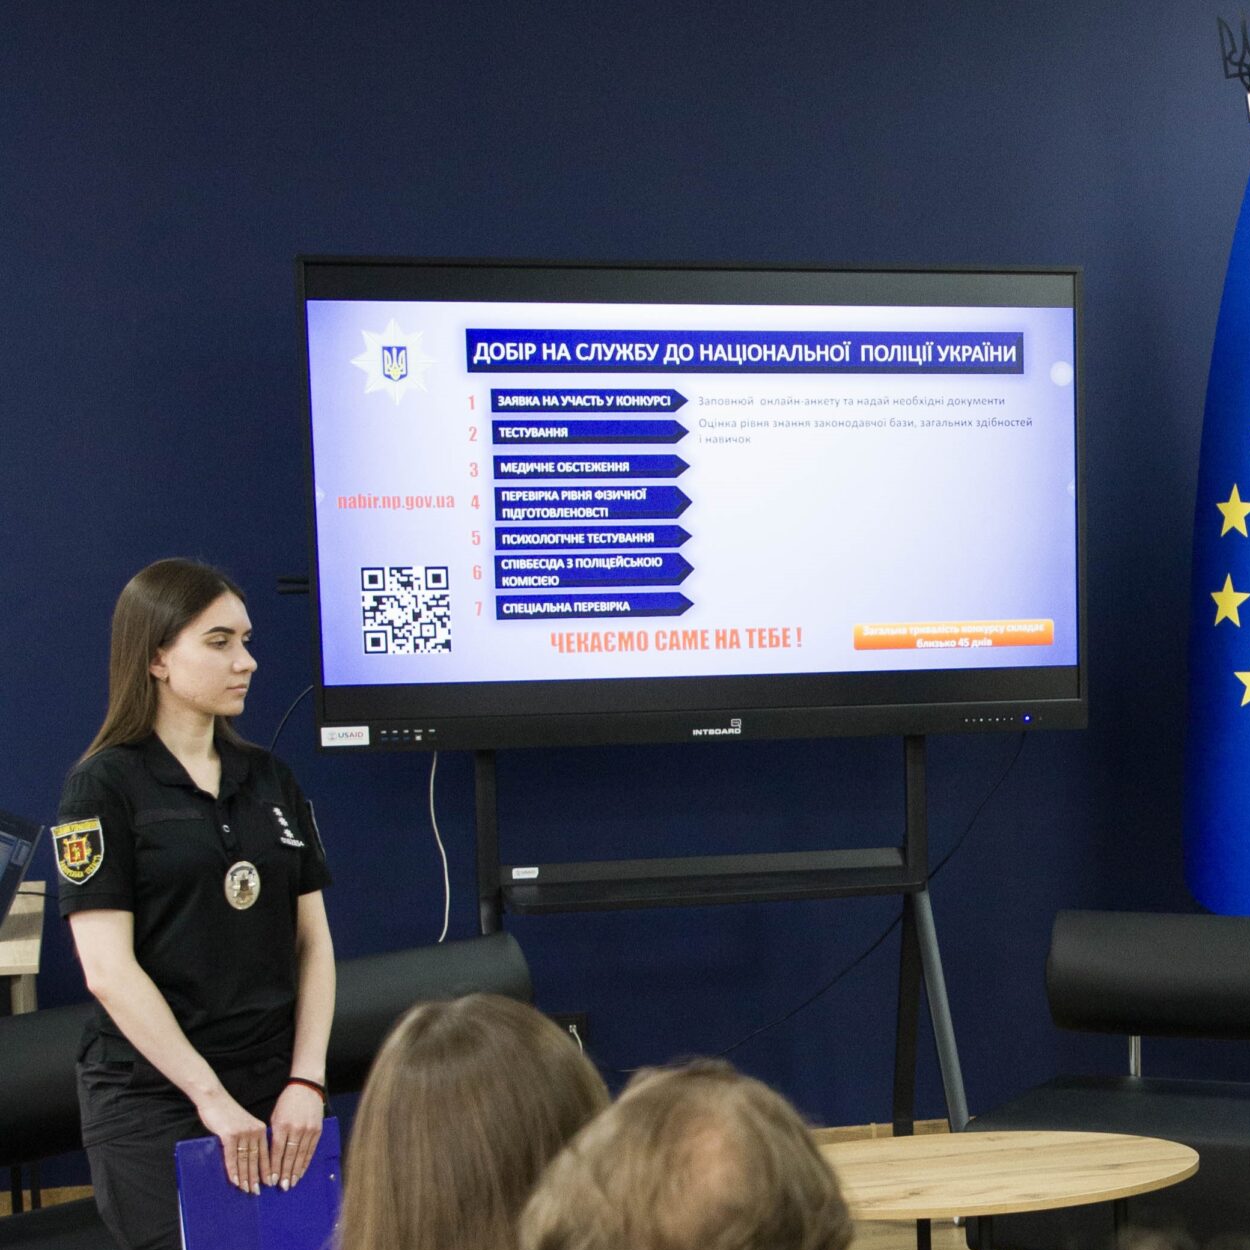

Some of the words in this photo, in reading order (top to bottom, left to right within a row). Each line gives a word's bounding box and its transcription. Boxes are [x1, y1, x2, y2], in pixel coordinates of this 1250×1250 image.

[472, 341, 537, 365] ДОБІР
[542, 342, 572, 361] НА
[575, 342, 659, 362] СЛУЖБУ
[663, 343, 695, 365] ДО
[699, 341, 852, 365] НАЦІОНАЛЬНОЇ
[860, 341, 935, 365] ПОЛІЦІЇ
[937, 342, 1017, 363] УКРАЇНИ
[468, 395, 476, 410] 1
[497, 395, 540, 407] ЗАЯВКА
[542, 395, 557, 406] НА
[559, 395, 604, 406] УЧАСТЬ
[605, 395, 615, 406] У
[616, 395, 671, 406] КОНКУРСІ
[698, 396, 755, 406] Заповнюй
[843, 398, 854, 406] та
[856, 396, 890, 407] надай
[893, 395, 945, 407] необхідні
[947, 397, 1005, 407] документи
[698, 418, 737, 429] Оцінка
[740, 418, 770, 430] рівня
[773, 419, 811, 428] знання
[813, 418, 887, 429] законодавчої
[920, 418, 973, 428] загальних
[976, 416, 1033, 429] здібностей
[468, 426, 478, 441] 2
[499, 427, 569, 438] ТЕСТУВАННЯ
[705, 435, 752, 444] навичок
[469, 462, 479, 477] 3
[500, 462, 555, 474] МЕДИЧНЕ
[557, 461, 630, 473] ОБСТЕЖЕННЯ
[336, 493, 455, 511] nabir.np.gov.ua
[471, 494, 480, 510] 4
[501, 490, 560, 502] ПЕРЕВІРКА
[561, 490, 592, 501] РІВНЯ
[594, 487, 647, 501] ФІЗИЧНОЇ
[471, 530, 481, 545] 5
[502, 533, 585, 545] ПСИХОЛОГІЧНЕ
[586, 532, 655, 543] ТЕСТУВАННЯ
[501, 558, 565, 571] СПІВБЕСІДА
[566, 558, 574, 568] З
[575, 555, 663, 570] ПОЛІЦЕЙСЬКОЮ
[472, 565, 482, 580] 6
[502, 575, 560, 587] КОМІСІЄЮ
[475, 601, 482, 616] 7
[502, 602, 572, 615] СПЕЦІАЛЬНА
[574, 601, 631, 612] ПЕРЕВІРКА
[550, 630, 649, 654] ЧЕКАЄМО
[654, 628, 711, 652] САМЕ
[714, 627, 742, 650] НА
[745, 627, 791, 650] ТЕБЕ
[337, 731, 364, 739] USAID
[692, 727, 741, 736] INTBOARD
